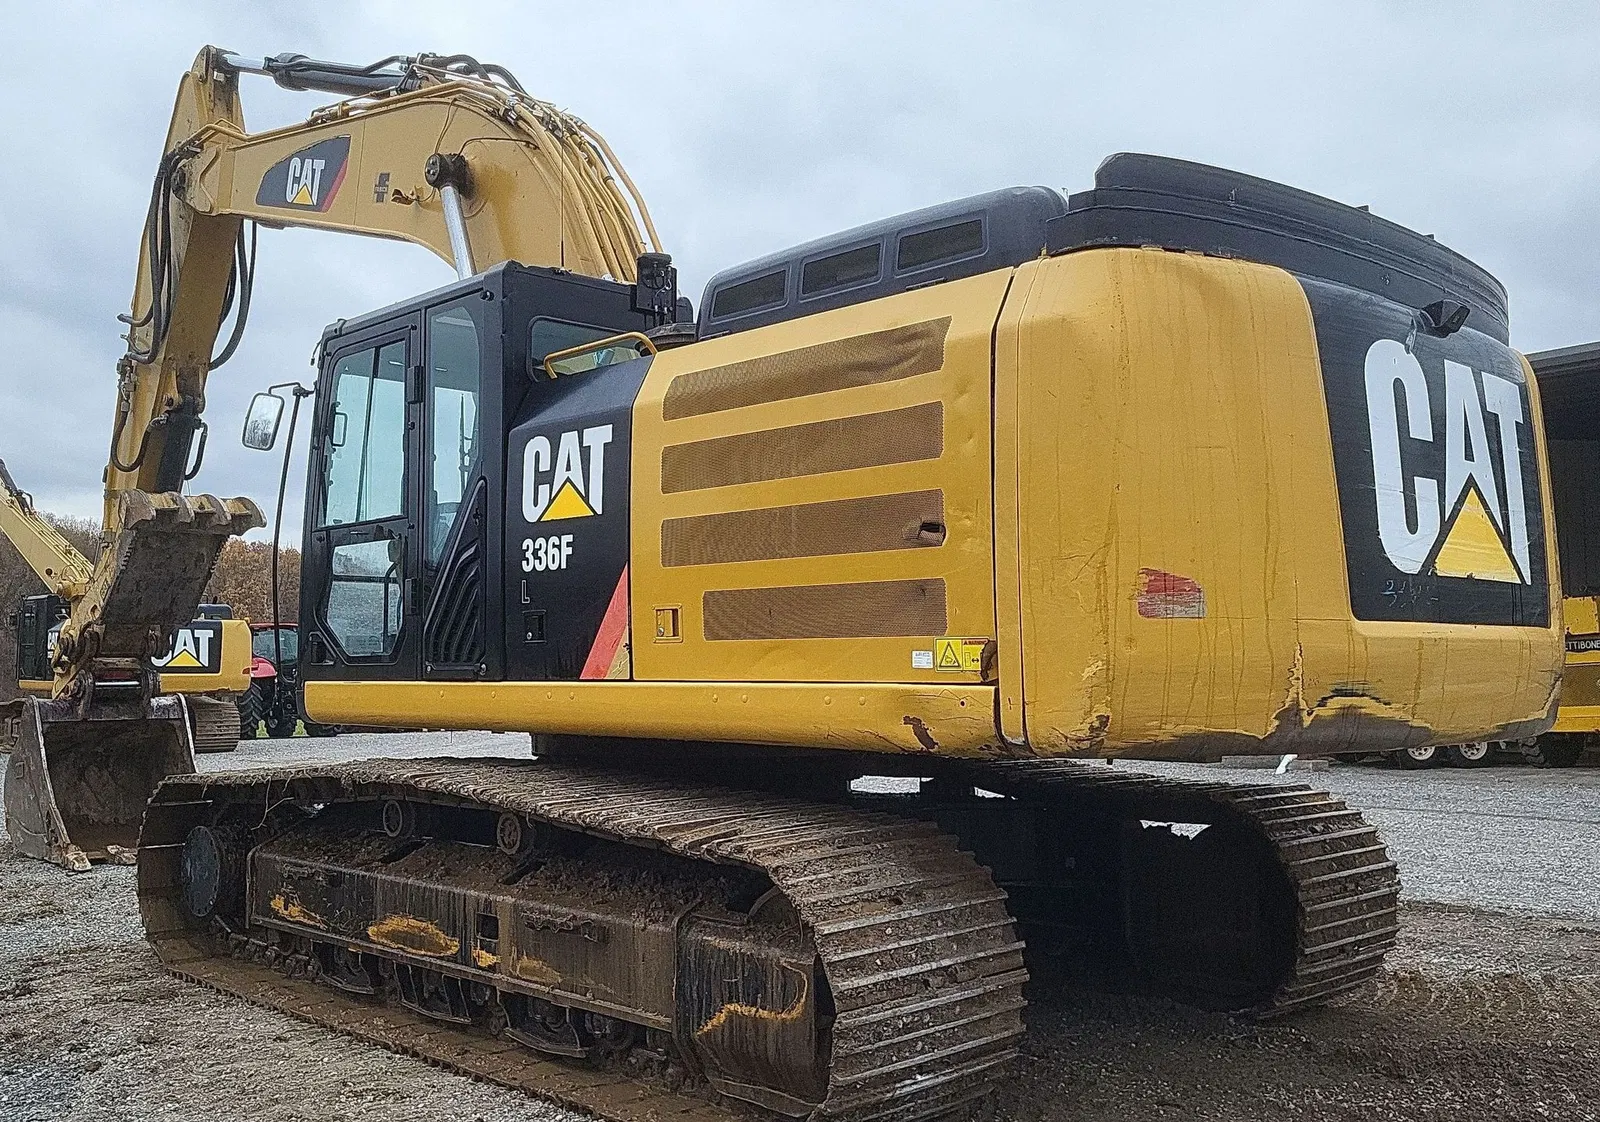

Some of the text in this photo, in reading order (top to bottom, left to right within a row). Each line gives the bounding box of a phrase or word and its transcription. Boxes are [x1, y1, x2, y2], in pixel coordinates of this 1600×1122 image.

[286, 157, 325, 205] CAT
[522, 424, 613, 523] CAT
[1364, 338, 1532, 586] CAT
[521, 534, 573, 572] 336F
[521, 579, 531, 604] L
